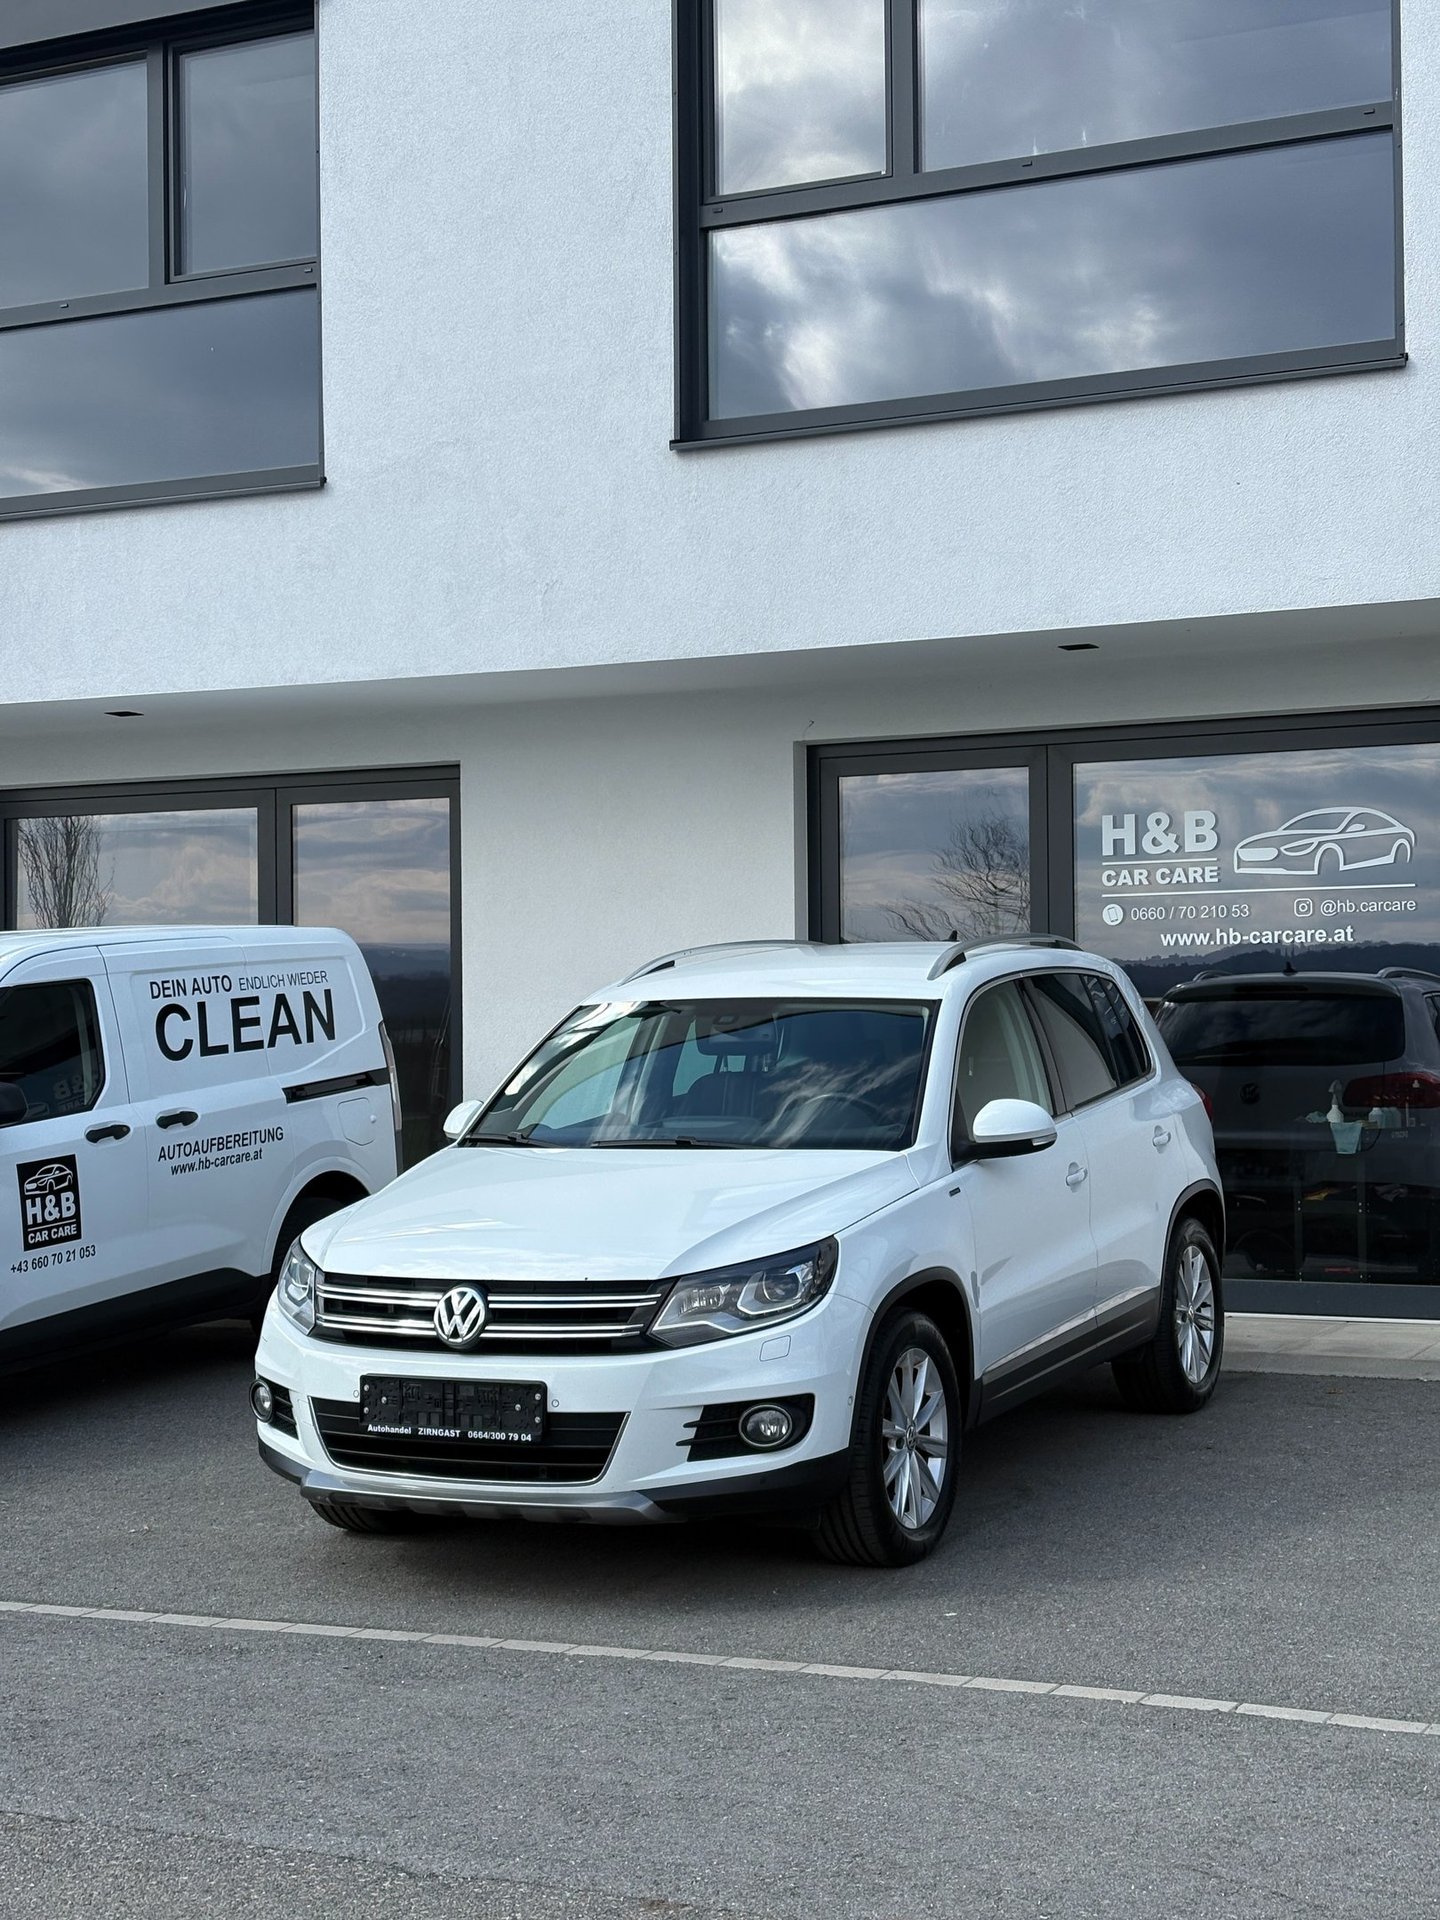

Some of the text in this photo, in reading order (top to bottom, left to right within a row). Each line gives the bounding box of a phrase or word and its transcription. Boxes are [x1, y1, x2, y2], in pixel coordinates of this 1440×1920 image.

[1101, 810, 1218, 856] H&B
[1101, 866, 1219, 887] CAR CARE
[1130, 907, 1166, 921] 0660
[1178, 906, 1197, 919] 70
[1200, 905, 1227, 918] 210
[1231, 904, 1250, 917] 53
[1320, 899, 1417, 917] @hb.carcare
[1160, 924, 1355, 947] www.hb-carcare.at
[149, 970, 329, 1000] DEIN AUTO ENDLICH WIEDER
[155, 988, 337, 1062] CLEAN
[157, 1126, 284, 1162] AUTOAUFBEREITUNG
[170, 1147, 264, 1176] www.hb-carcare.at
[26, 1191, 76, 1225] H&B
[28, 1224, 77, 1244] CAR CARE
[10, 1244, 97, 1273] +43 660 70 21 053
[367, 1424, 532, 1442] Autohandel ZIRNGAST 0664/300 79 04
